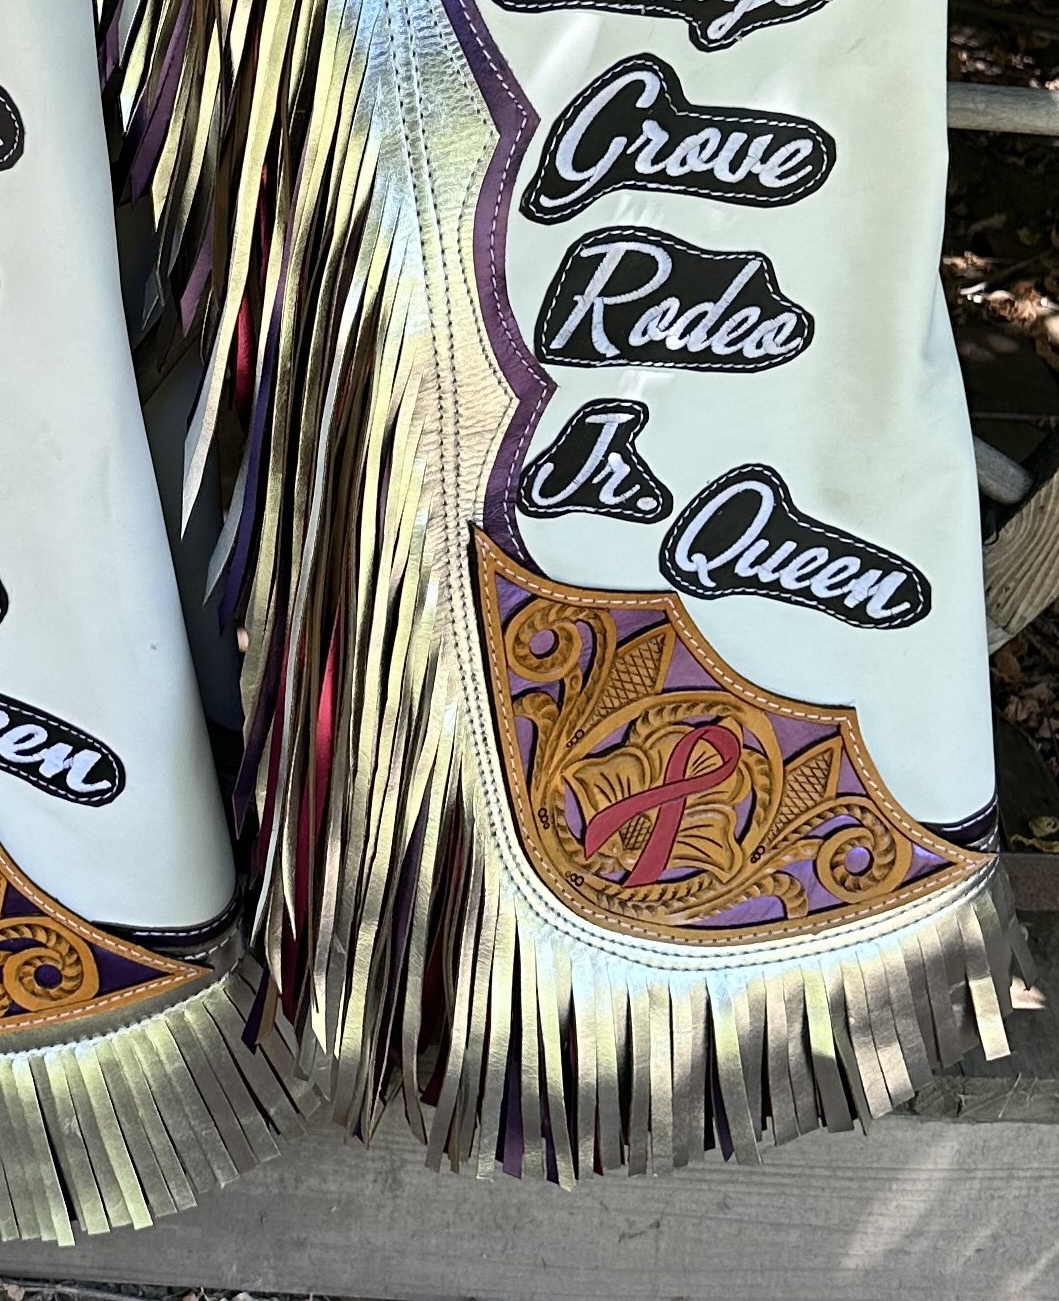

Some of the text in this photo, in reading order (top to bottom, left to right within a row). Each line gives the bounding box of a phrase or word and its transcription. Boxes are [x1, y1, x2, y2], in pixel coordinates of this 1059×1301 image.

[539, 70, 813, 208] Grove
[550, 242, 803, 358] Rodeo
[532, 413, 911, 619] Jr. Queen
